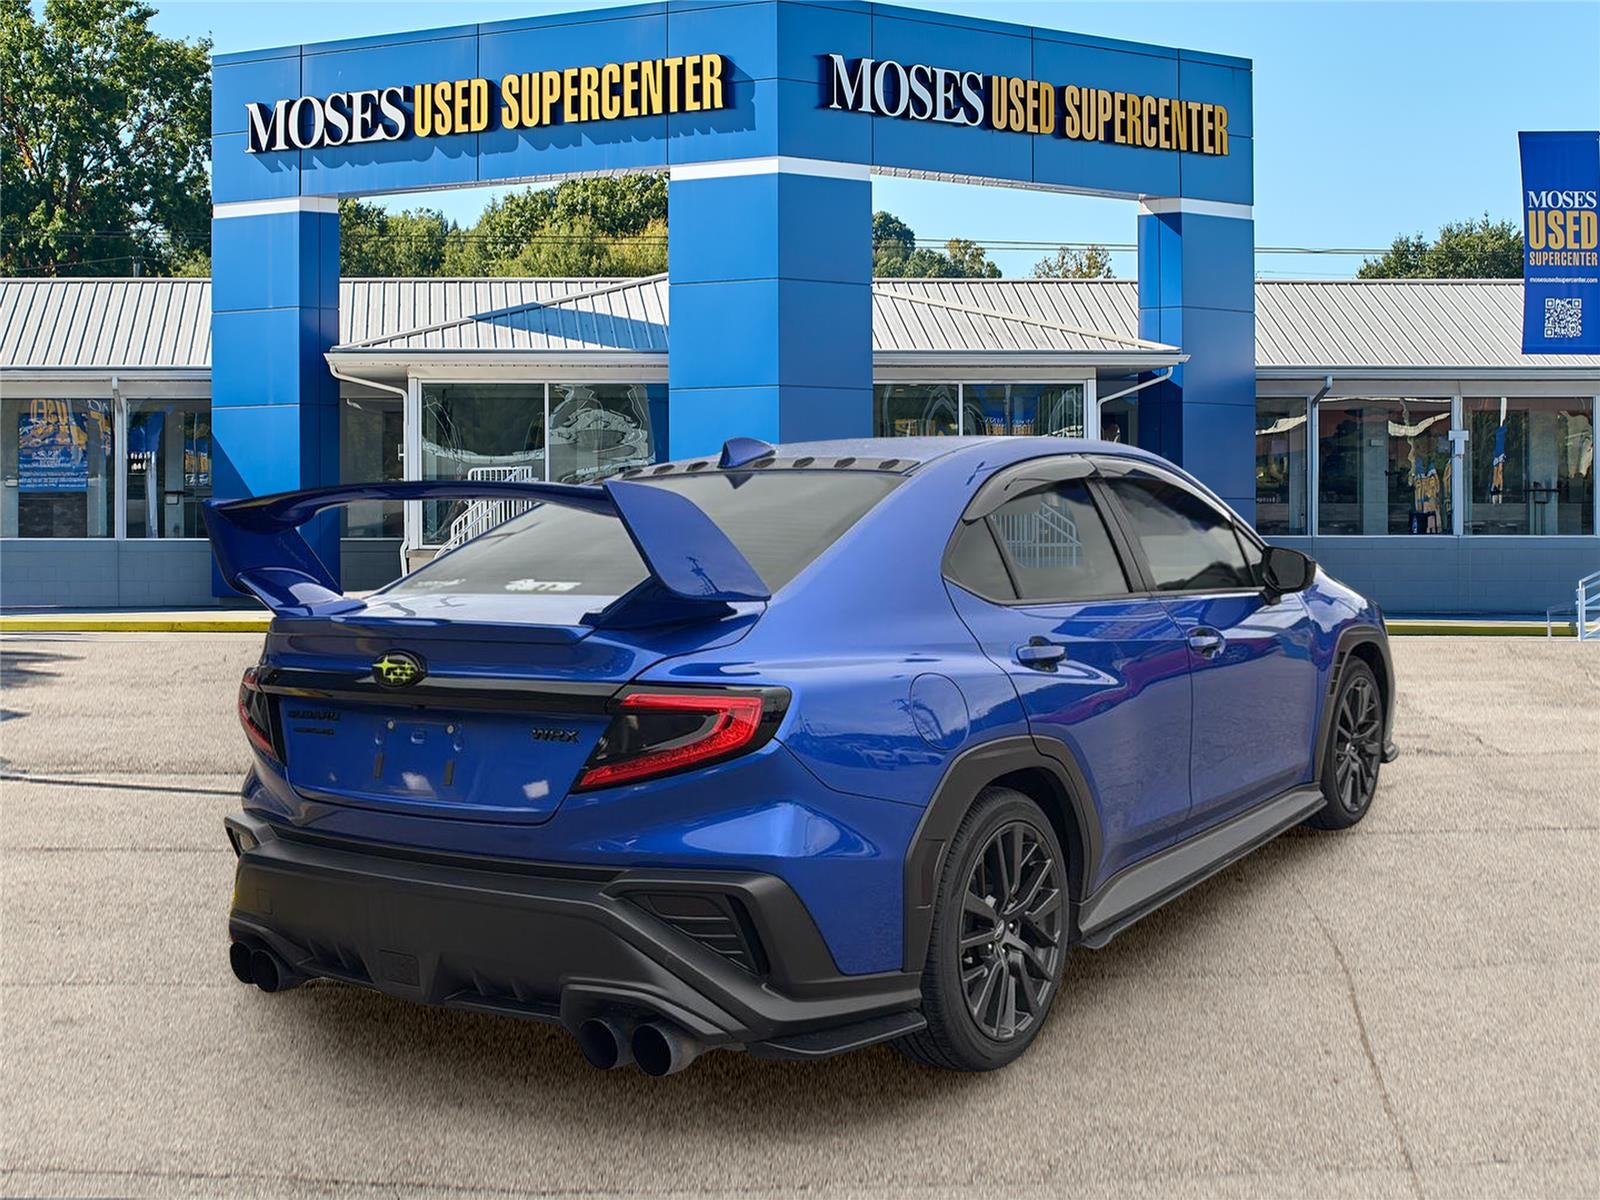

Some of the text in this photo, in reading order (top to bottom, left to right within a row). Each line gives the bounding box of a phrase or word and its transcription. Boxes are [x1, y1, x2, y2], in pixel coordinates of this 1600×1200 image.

[244, 53, 725, 154] MOSES USED SUPERCENTER
[829, 53, 1230, 156] MOSES USED SUPERCENTER
[1527, 190, 1597, 209] MOSES
[1527, 210, 1598, 250] USED
[1529, 251, 1598, 267] SUPERCENTER
[531, 727, 580, 744] WRX
